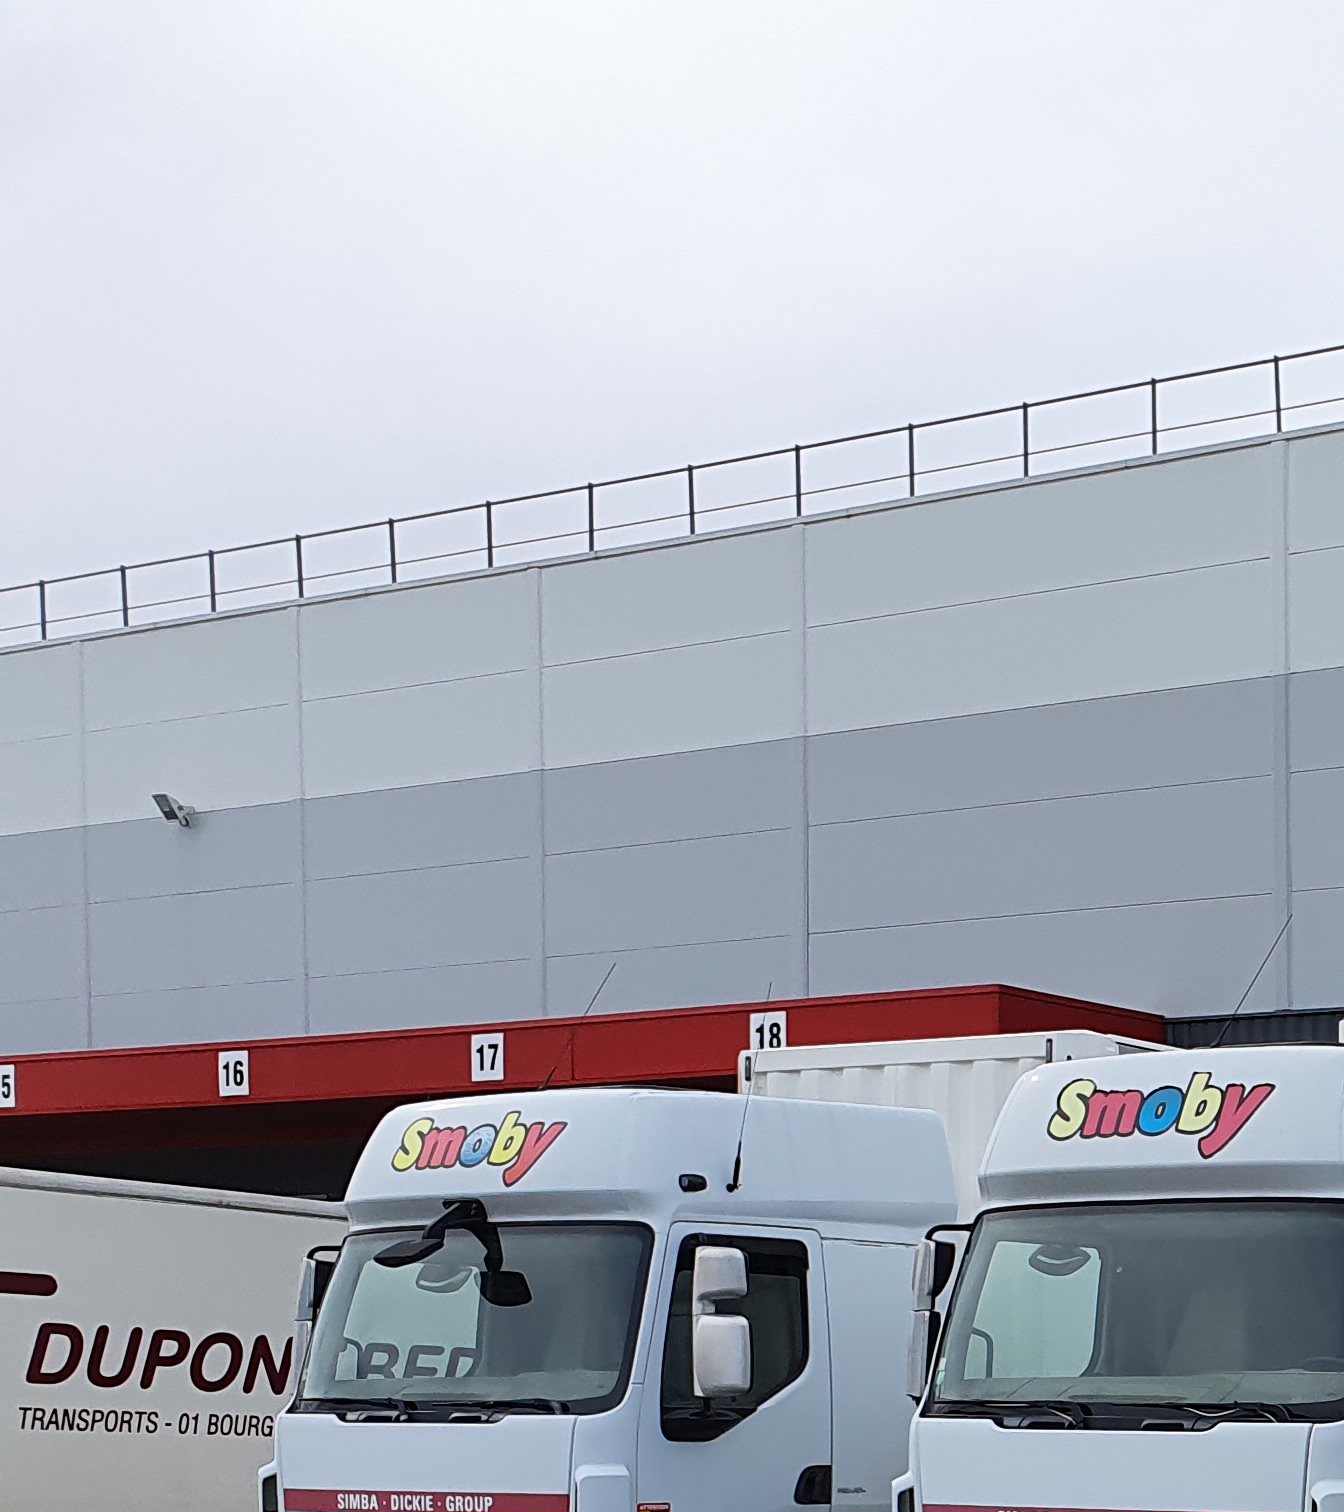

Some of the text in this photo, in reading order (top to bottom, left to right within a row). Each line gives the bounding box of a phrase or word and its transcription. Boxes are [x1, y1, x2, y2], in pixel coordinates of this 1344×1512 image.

[754, 1022, 781, 1049] 18
[475, 1043, 499, 1071] 17
[1, 1074, 11, 1099] 5
[222, 1060, 244, 1087] 16
[1047, 1071, 1276, 1159] Smoby
[391, 1110, 568, 1188] Smoby
[25, 1322, 294, 1396] DUPON
[18, 1406, 159, 1434] TRANSPORTS
[178, 1413, 200, 1435] 01
[206, 1413, 274, 1438] BOURG
[337, 1492, 378, 1511] SIMBA
[390, 1494, 434, 1512] DICKIE
[445, 1495, 493, 1512] GROUP
